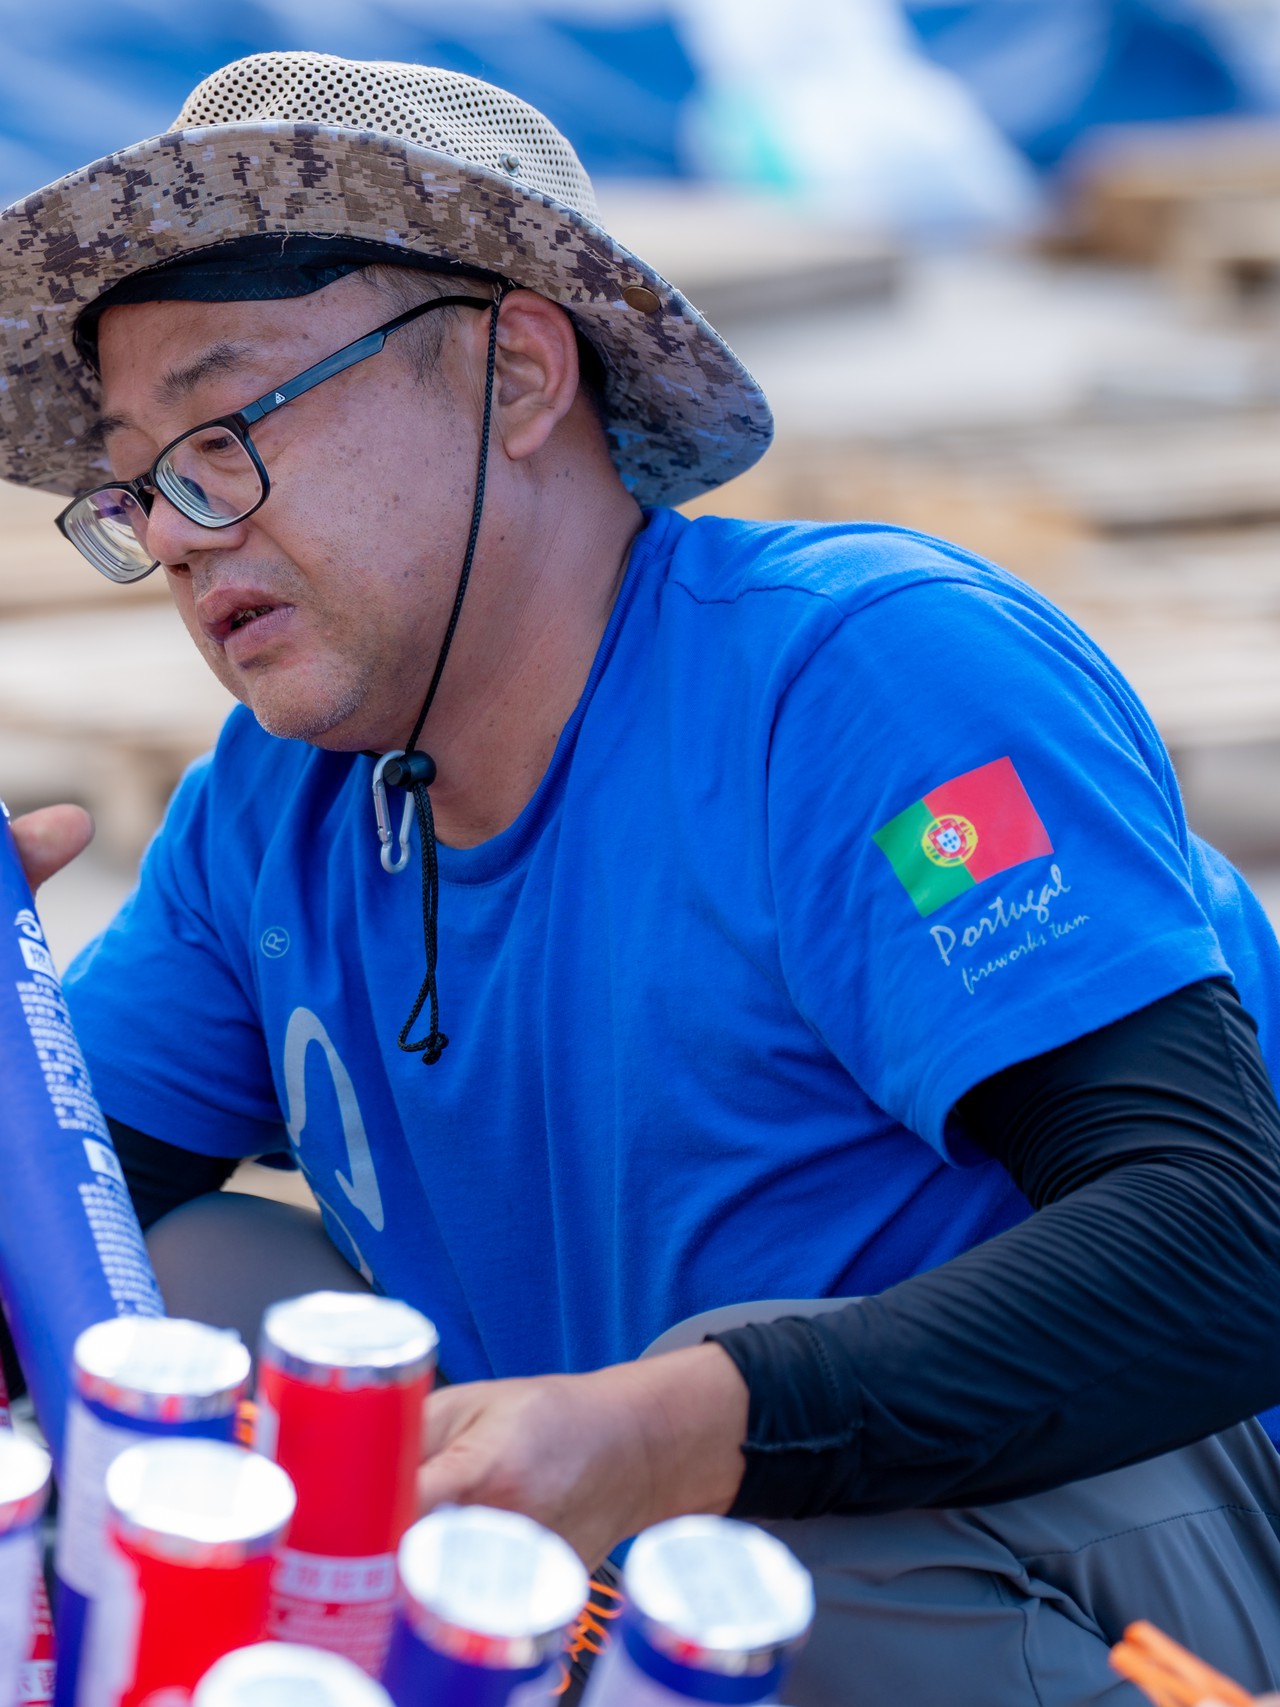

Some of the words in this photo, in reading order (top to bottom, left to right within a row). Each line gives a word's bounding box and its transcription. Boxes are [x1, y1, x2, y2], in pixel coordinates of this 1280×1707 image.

[930, 864, 1070, 966] Portugal
[962, 931, 1047, 995] fireworks
[1050, 914, 1090, 938] team
